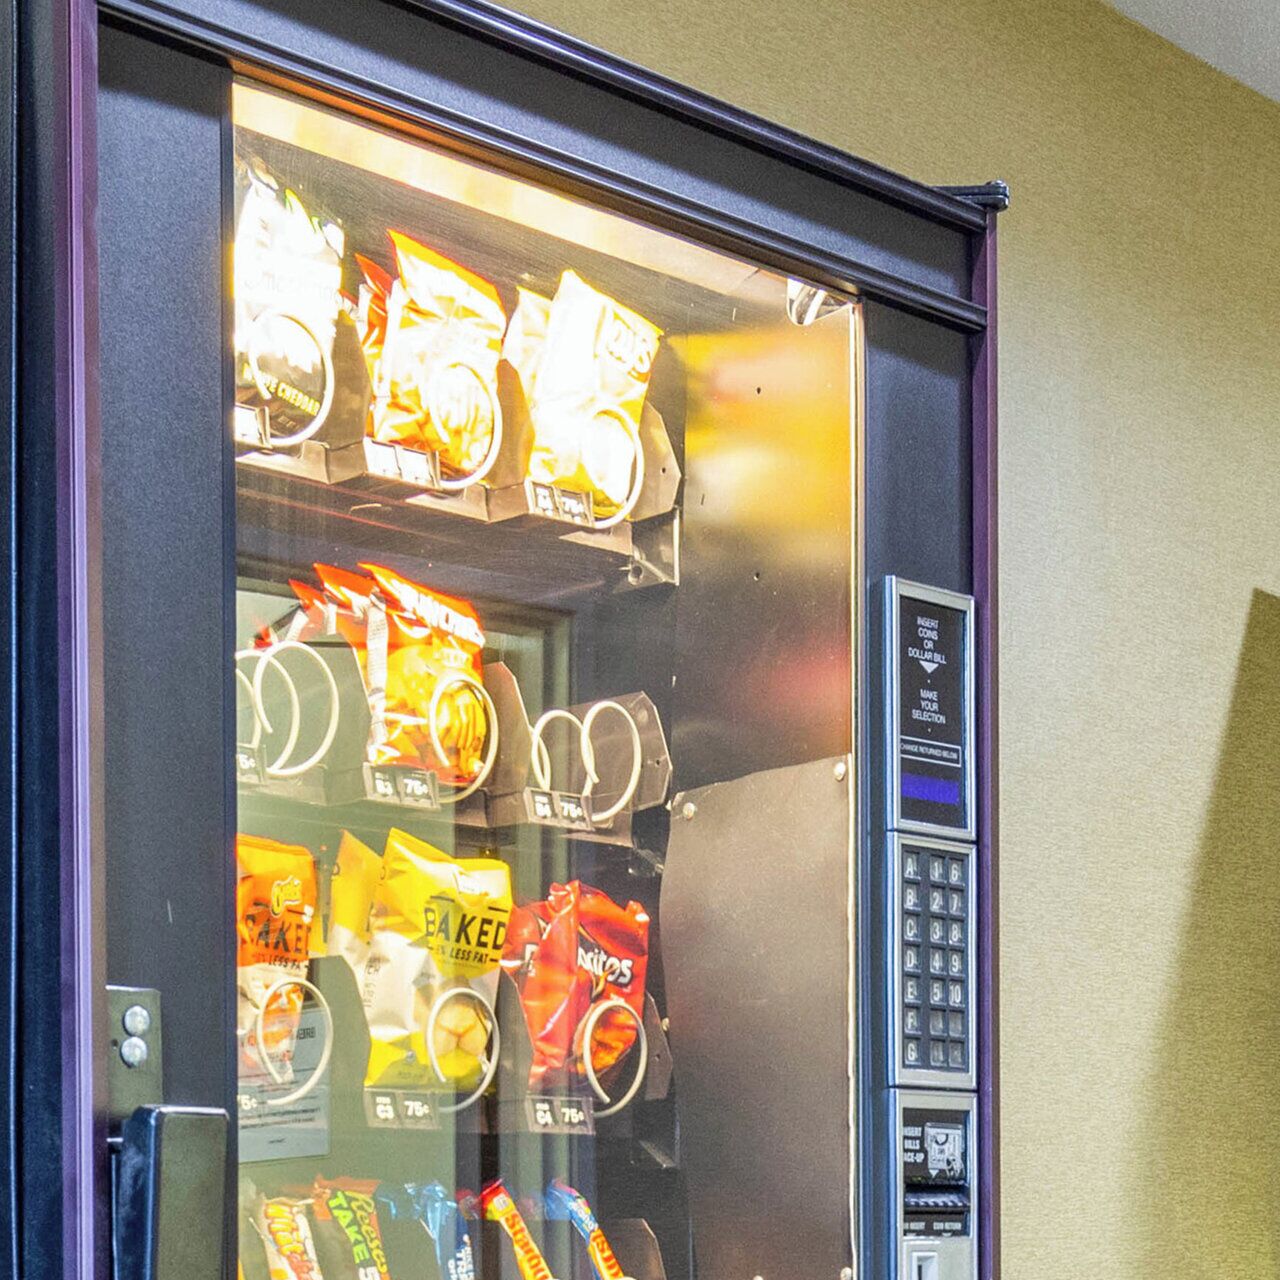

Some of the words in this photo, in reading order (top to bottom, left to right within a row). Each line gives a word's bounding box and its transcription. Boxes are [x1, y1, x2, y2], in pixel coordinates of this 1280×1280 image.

[917, 615, 939, 630] INSERT
[923, 638, 934, 651] OR
[908, 646, 934, 662] DOLLAR
[933, 651, 947, 665] BILL
[920, 688, 938, 702] MAKE
[920, 699, 939, 713] YOUR
[911, 709, 946, 725] SELECTION
[906, 857, 914, 876] A
[933, 861, 939, 879] 1
[951, 863, 959, 881] 6
[906, 888, 914, 907] B
[932, 891, 940, 909] 2
[951, 894, 959, 912] 7
[424, 907, 507, 950] BAKED
[906, 919, 915, 937] C
[932, 922, 940, 940] 3
[951, 924, 959, 942] 8
[450, 947, 471, 961] LESS
[472, 951, 489, 964] FAT
[906, 950, 915, 968] D
[932, 953, 941, 971] 4
[951, 954, 959, 972] 9
[907, 981, 915, 999] E
[932, 983, 941, 1001] 5
[950, 984, 961, 1003] 10
[907, 1012, 914, 1030] F
[907, 1043, 915, 1060] G
[404, 1101, 429, 1118] 75¢
[561, 1108, 585, 1123] 75¢
[328, 1190, 370, 1264] TAKE
